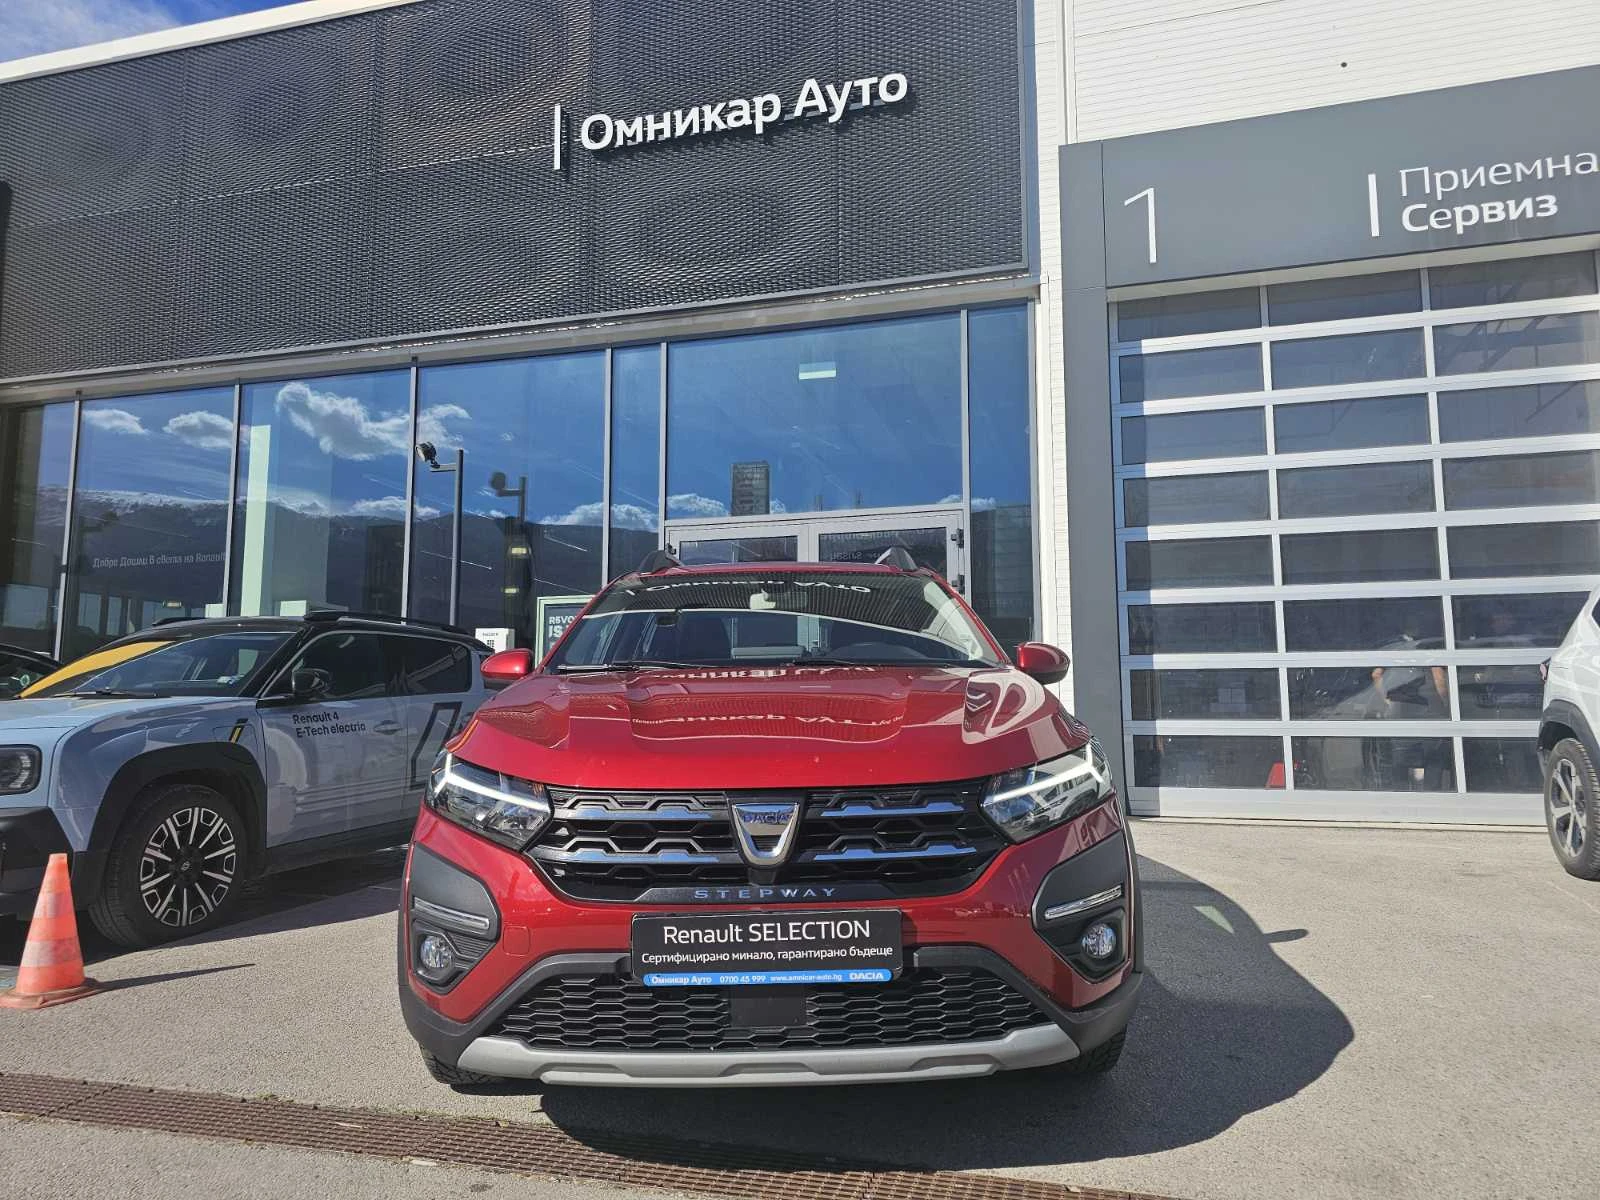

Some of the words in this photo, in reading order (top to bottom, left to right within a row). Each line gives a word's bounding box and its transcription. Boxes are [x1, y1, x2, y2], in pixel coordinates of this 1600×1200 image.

[580, 93, 782, 150] Омникар
[794, 72, 908, 123] Ауто
[1399, 150, 1599, 200] Приемна
[1401, 193, 1558, 235] Сервиз
[1123, 187, 1158, 264] 1
[292, 711, 331, 724] Renault
[332, 711, 340, 721] 4
[296, 724, 330, 738] E-Tech
[330, 722, 367, 735] electric
[694, 887, 836, 899] STEPWAY
[663, 924, 743, 944] Renault
[748, 920, 871, 942] SELECTION
[641, 951, 730, 966] Сертифицирано
[731, 950, 776, 962] минало,
[777, 948, 847, 961] гарантирано
[848, 945, 893, 958] бъдеще
[691, 976, 712, 984] Ауто
[719, 975, 740, 983] 0700
[740, 975, 750, 983] 45
[848, 972, 884, 980] DACIA
